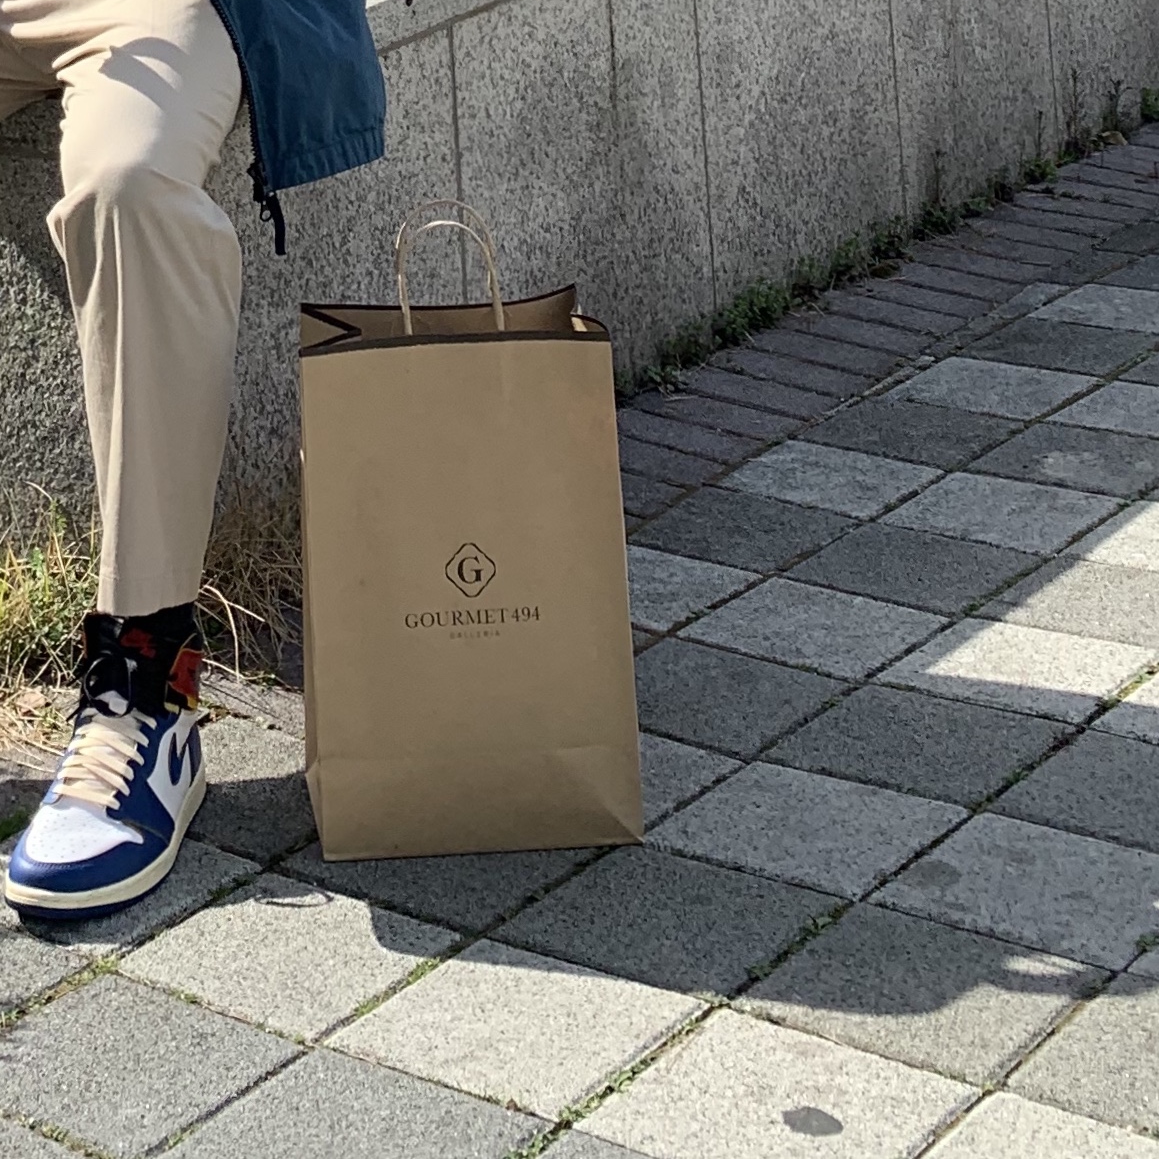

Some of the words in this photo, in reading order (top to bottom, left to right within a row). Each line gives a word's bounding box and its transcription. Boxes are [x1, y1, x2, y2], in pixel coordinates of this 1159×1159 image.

[457, 555, 484, 584] G
[404, 608, 509, 629] GOURMET
[511, 605, 541, 623] 494
